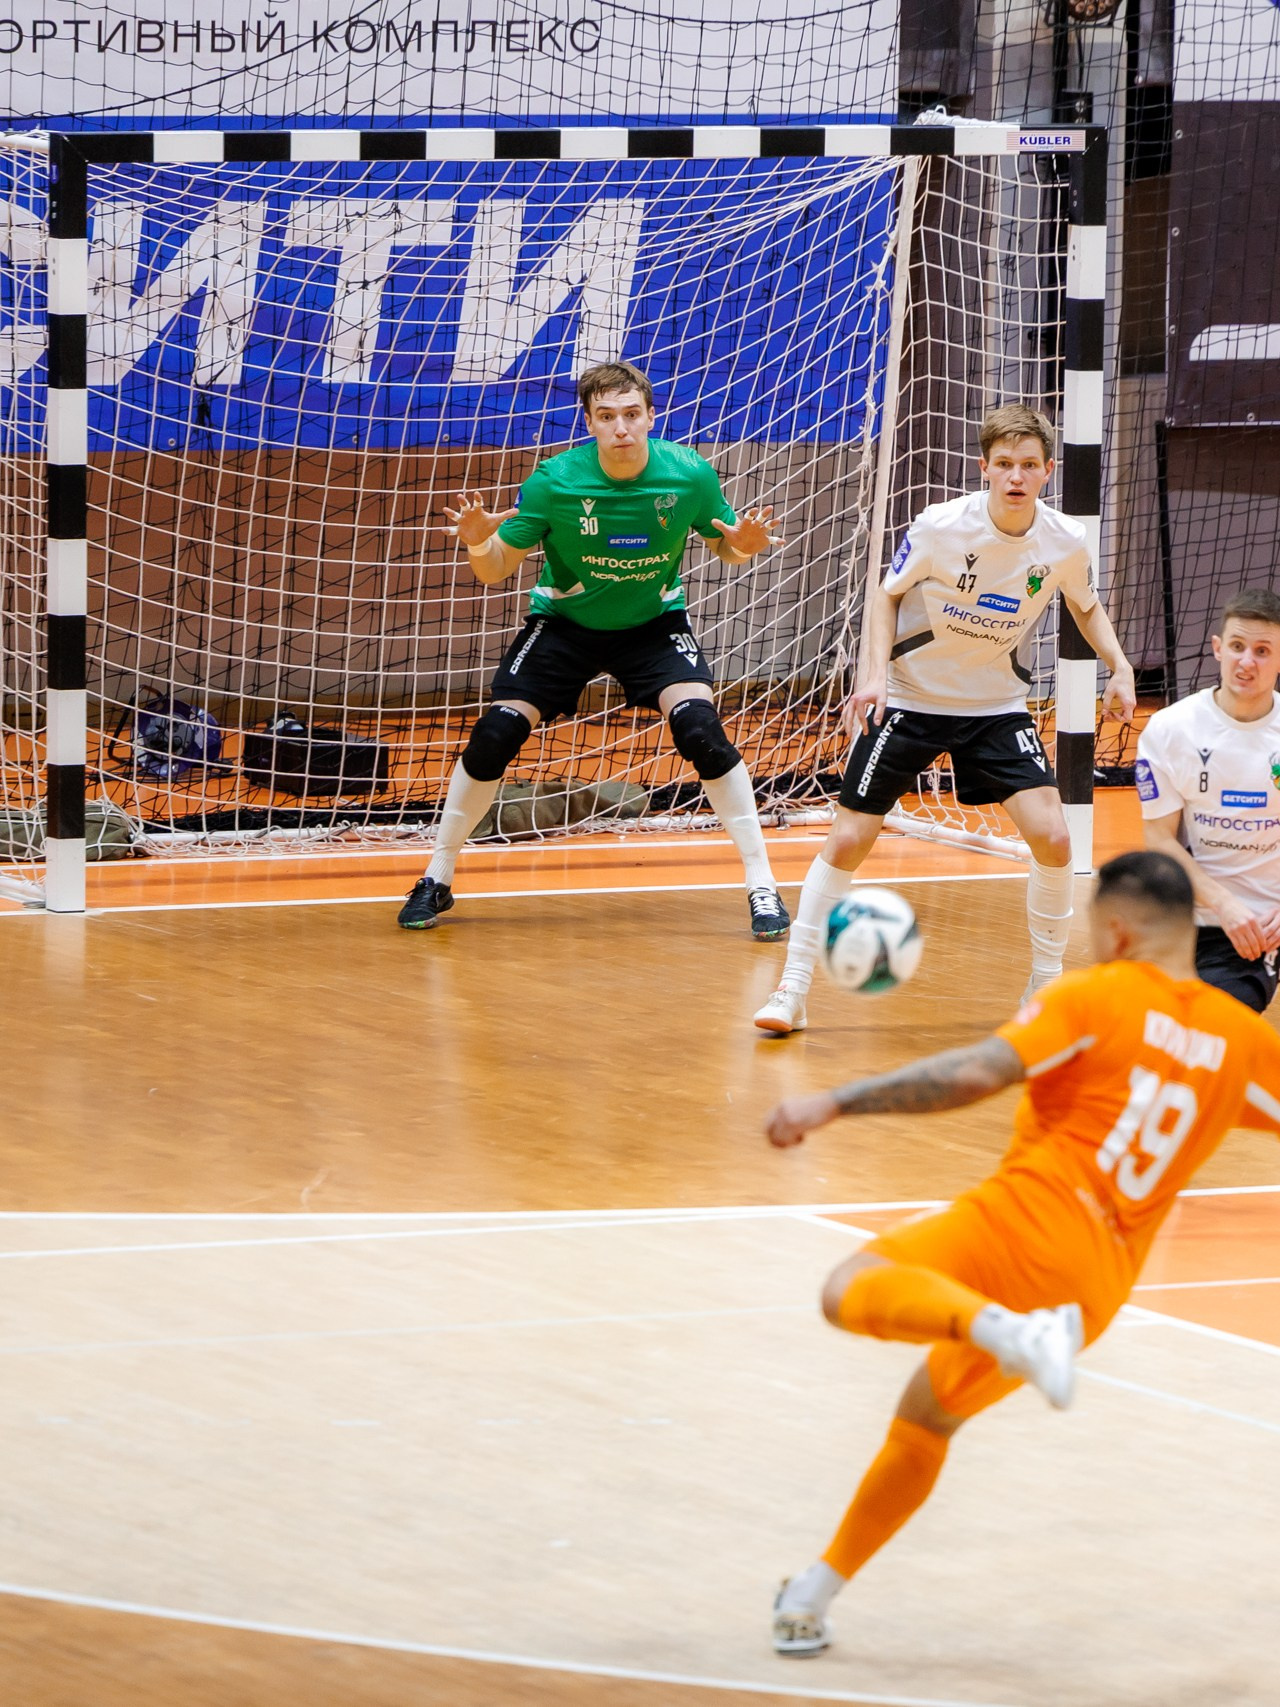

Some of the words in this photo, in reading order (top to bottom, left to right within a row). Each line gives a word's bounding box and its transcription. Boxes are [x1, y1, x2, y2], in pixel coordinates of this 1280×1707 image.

[0, 11, 286, 53] ОРТИВНЫЙ
[312, 20, 600, 53] КОМПЛЕКС
[1019, 134, 1071, 145] KÜBLER
[579, 516, 599, 536] 30
[581, 552, 670, 569] ИНГОССТРАХ
[956, 573, 977, 593] 47
[670, 633, 698, 653] 30
[1015, 728, 1042, 754] 47
[857, 721, 893, 797] CORDIANT
[1200, 772, 1208, 793] 8
[1200, 838, 1258, 852] NORMAN
[1097, 1065, 1198, 1200] 19
